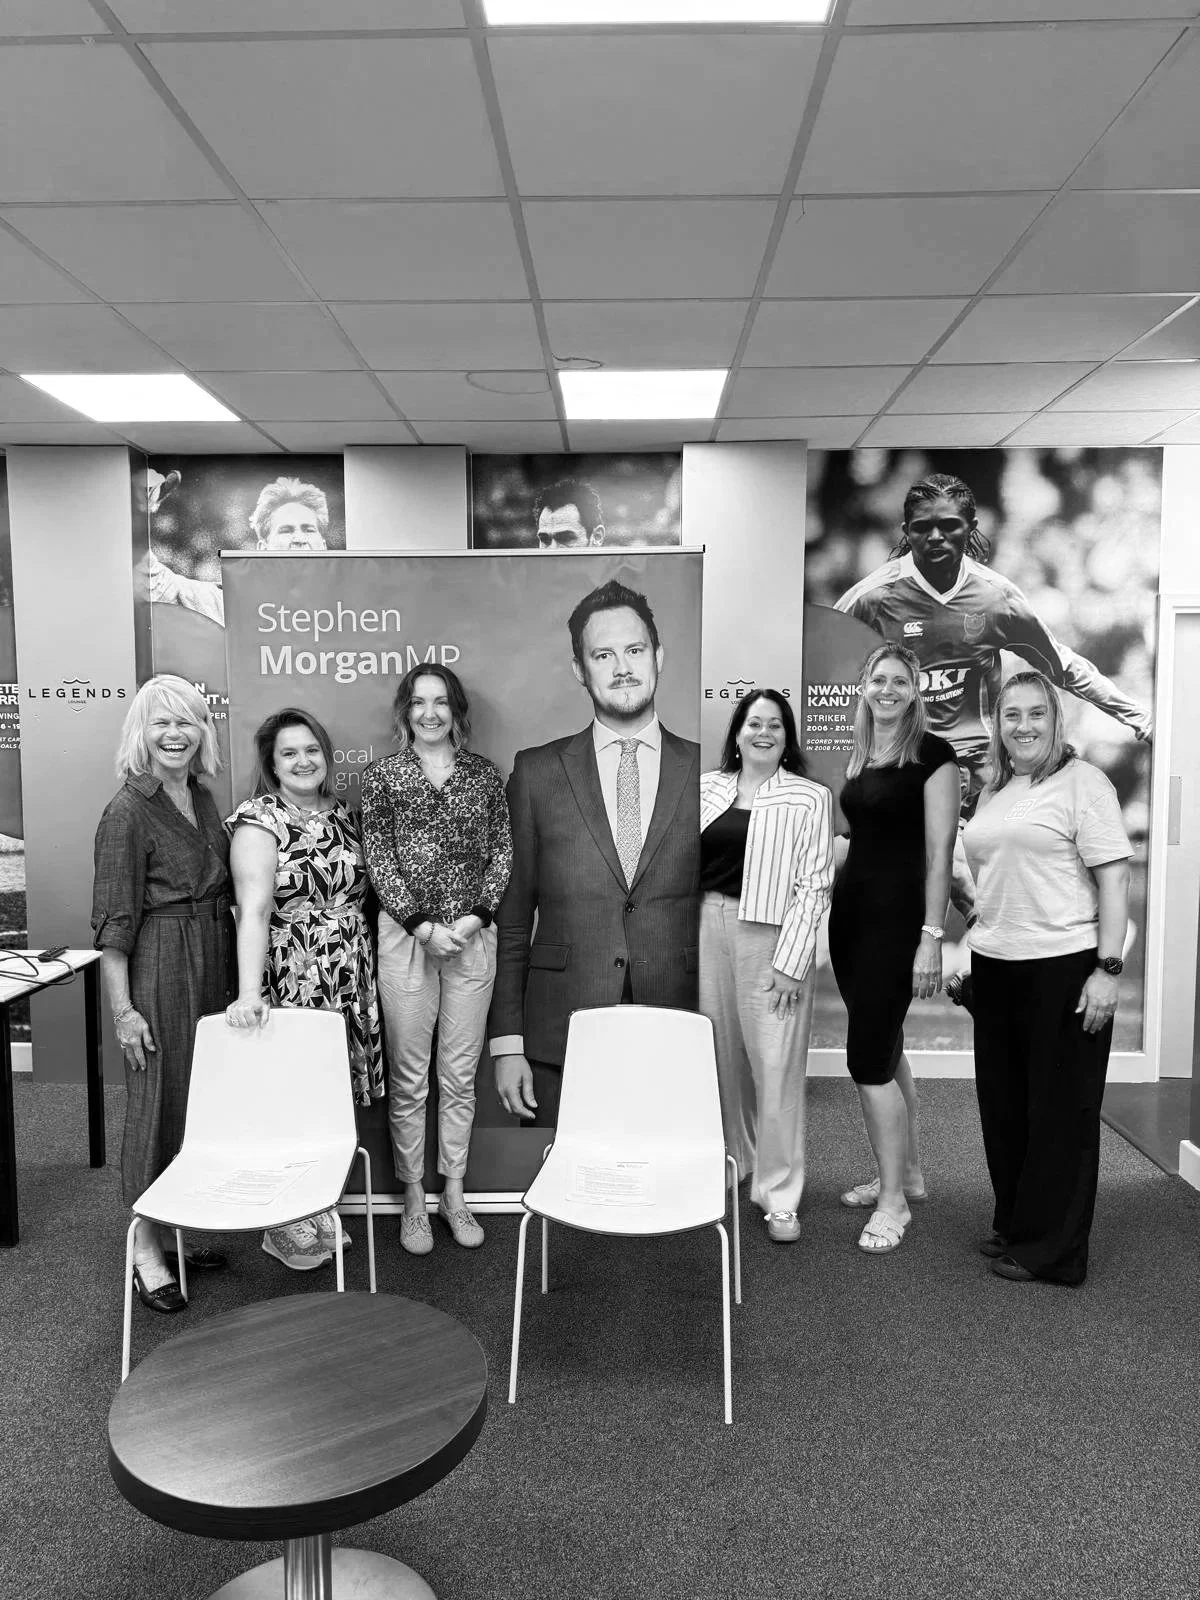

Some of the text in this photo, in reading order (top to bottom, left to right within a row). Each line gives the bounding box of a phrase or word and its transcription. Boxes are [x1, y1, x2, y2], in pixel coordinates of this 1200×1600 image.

[258, 601, 401, 642] Stephen
[28, 688, 126, 698] LEGENDS
[807, 685, 862, 695] NWANK
[807, 696, 850, 706] KANU
[807, 714, 847, 722] STRIKER
[334, 745, 373, 763] ocal
